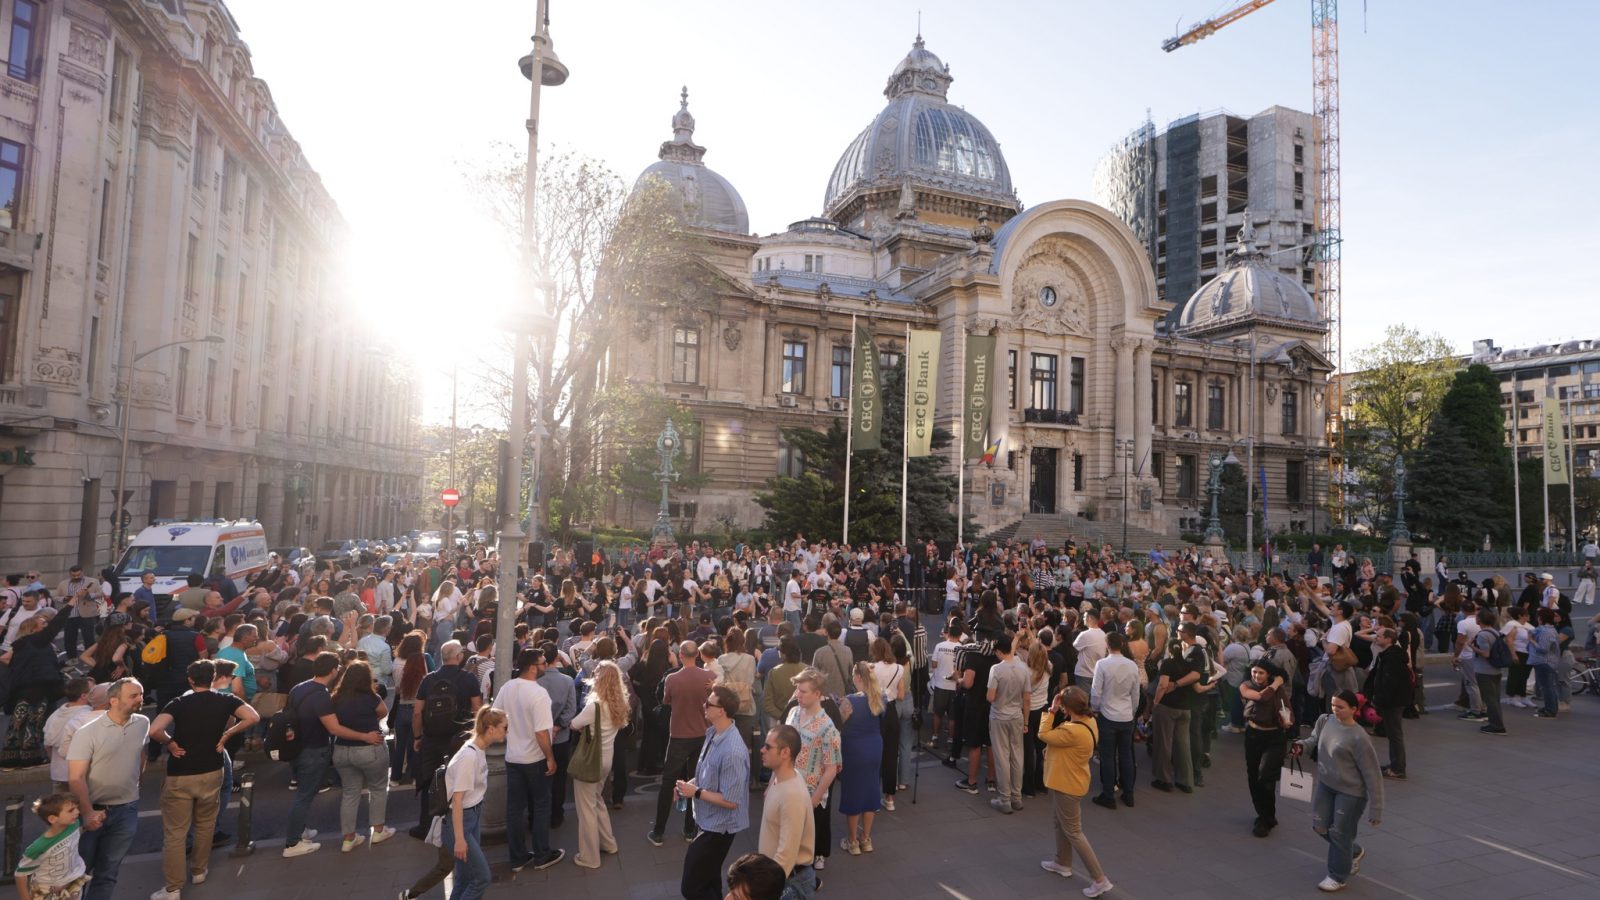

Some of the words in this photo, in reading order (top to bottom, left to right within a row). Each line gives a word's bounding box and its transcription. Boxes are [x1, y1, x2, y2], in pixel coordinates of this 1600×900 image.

[862, 340, 874, 381] Bank
[917, 350, 930, 388] Bank
[973, 354, 986, 393] Bank
[861, 400, 873, 432] CEC
[916, 408, 926, 439] CEC
[972, 411, 983, 442] CEC
